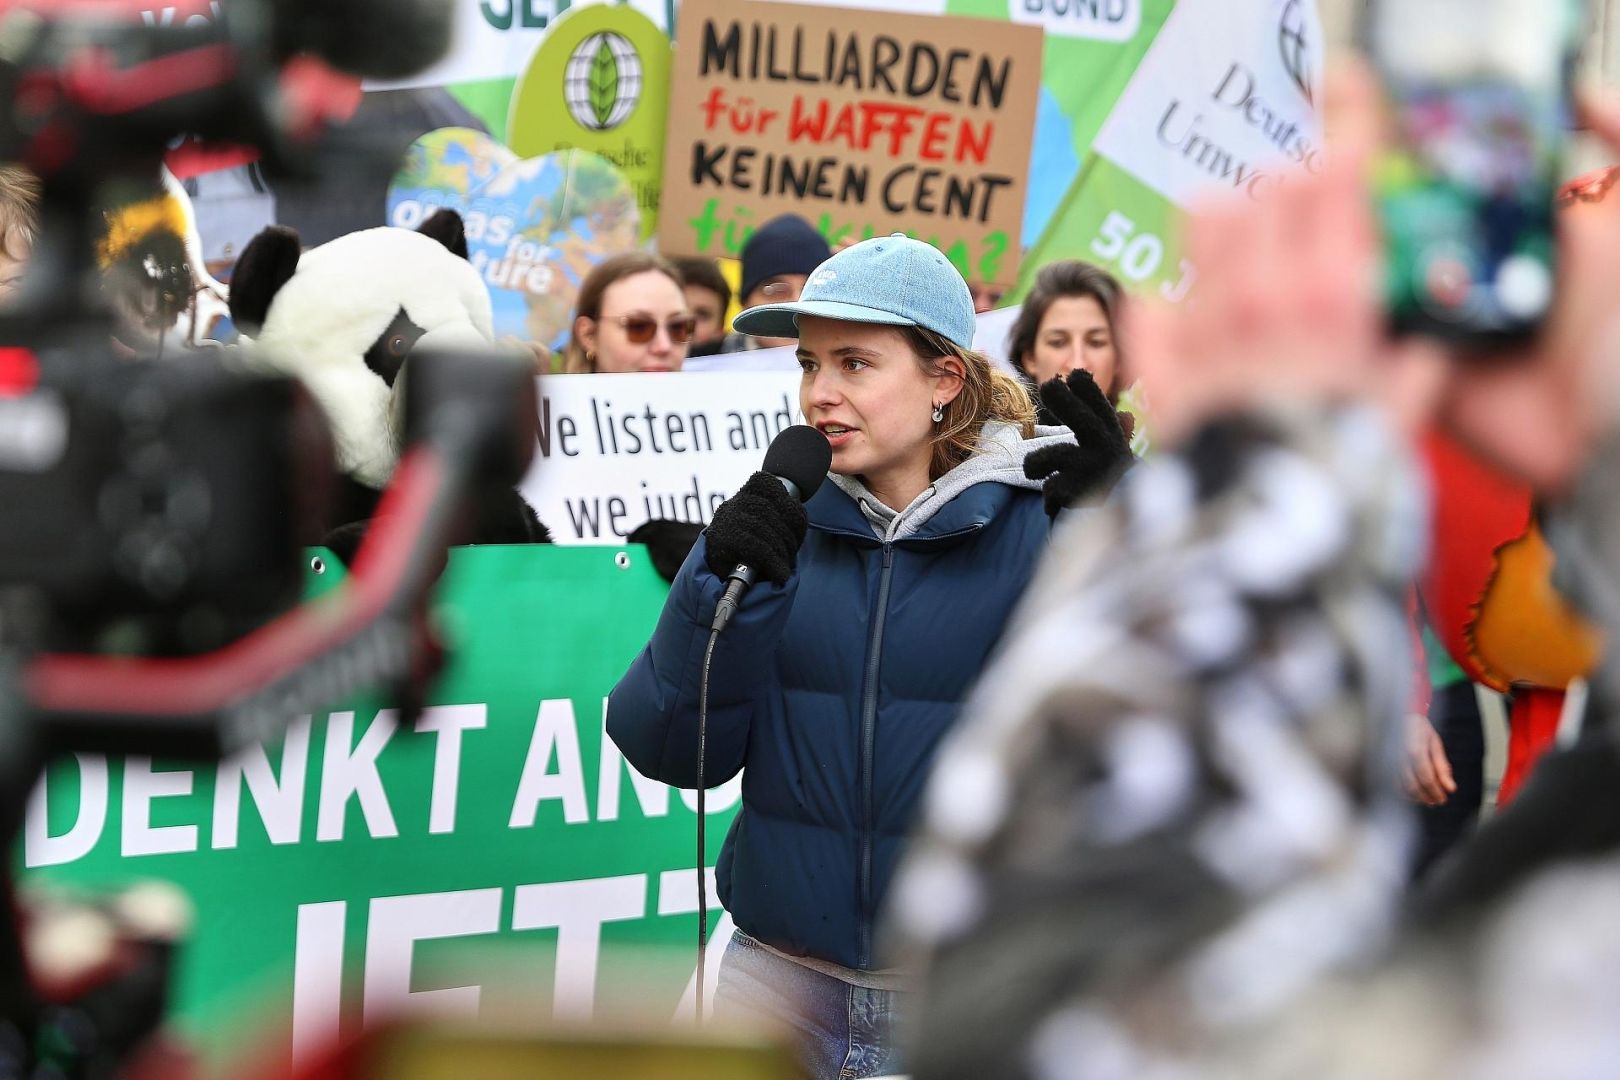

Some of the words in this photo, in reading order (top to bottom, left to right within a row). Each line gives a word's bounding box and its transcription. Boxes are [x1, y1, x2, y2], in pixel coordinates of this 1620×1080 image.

[700, 19, 1012, 109] MILLIARDEN
[699, 87, 779, 135] für
[788, 94, 995, 165] WAFFEN
[691, 141, 870, 207] KEINEN
[882, 164, 1014, 226] CENT
[688, 199, 756, 253] fü
[1091, 210, 1164, 280] 50
[592, 397, 713, 455] listen
[727, 394, 793, 452] and
[566, 496, 628, 539] we
[25, 703, 487, 868] DENKT
